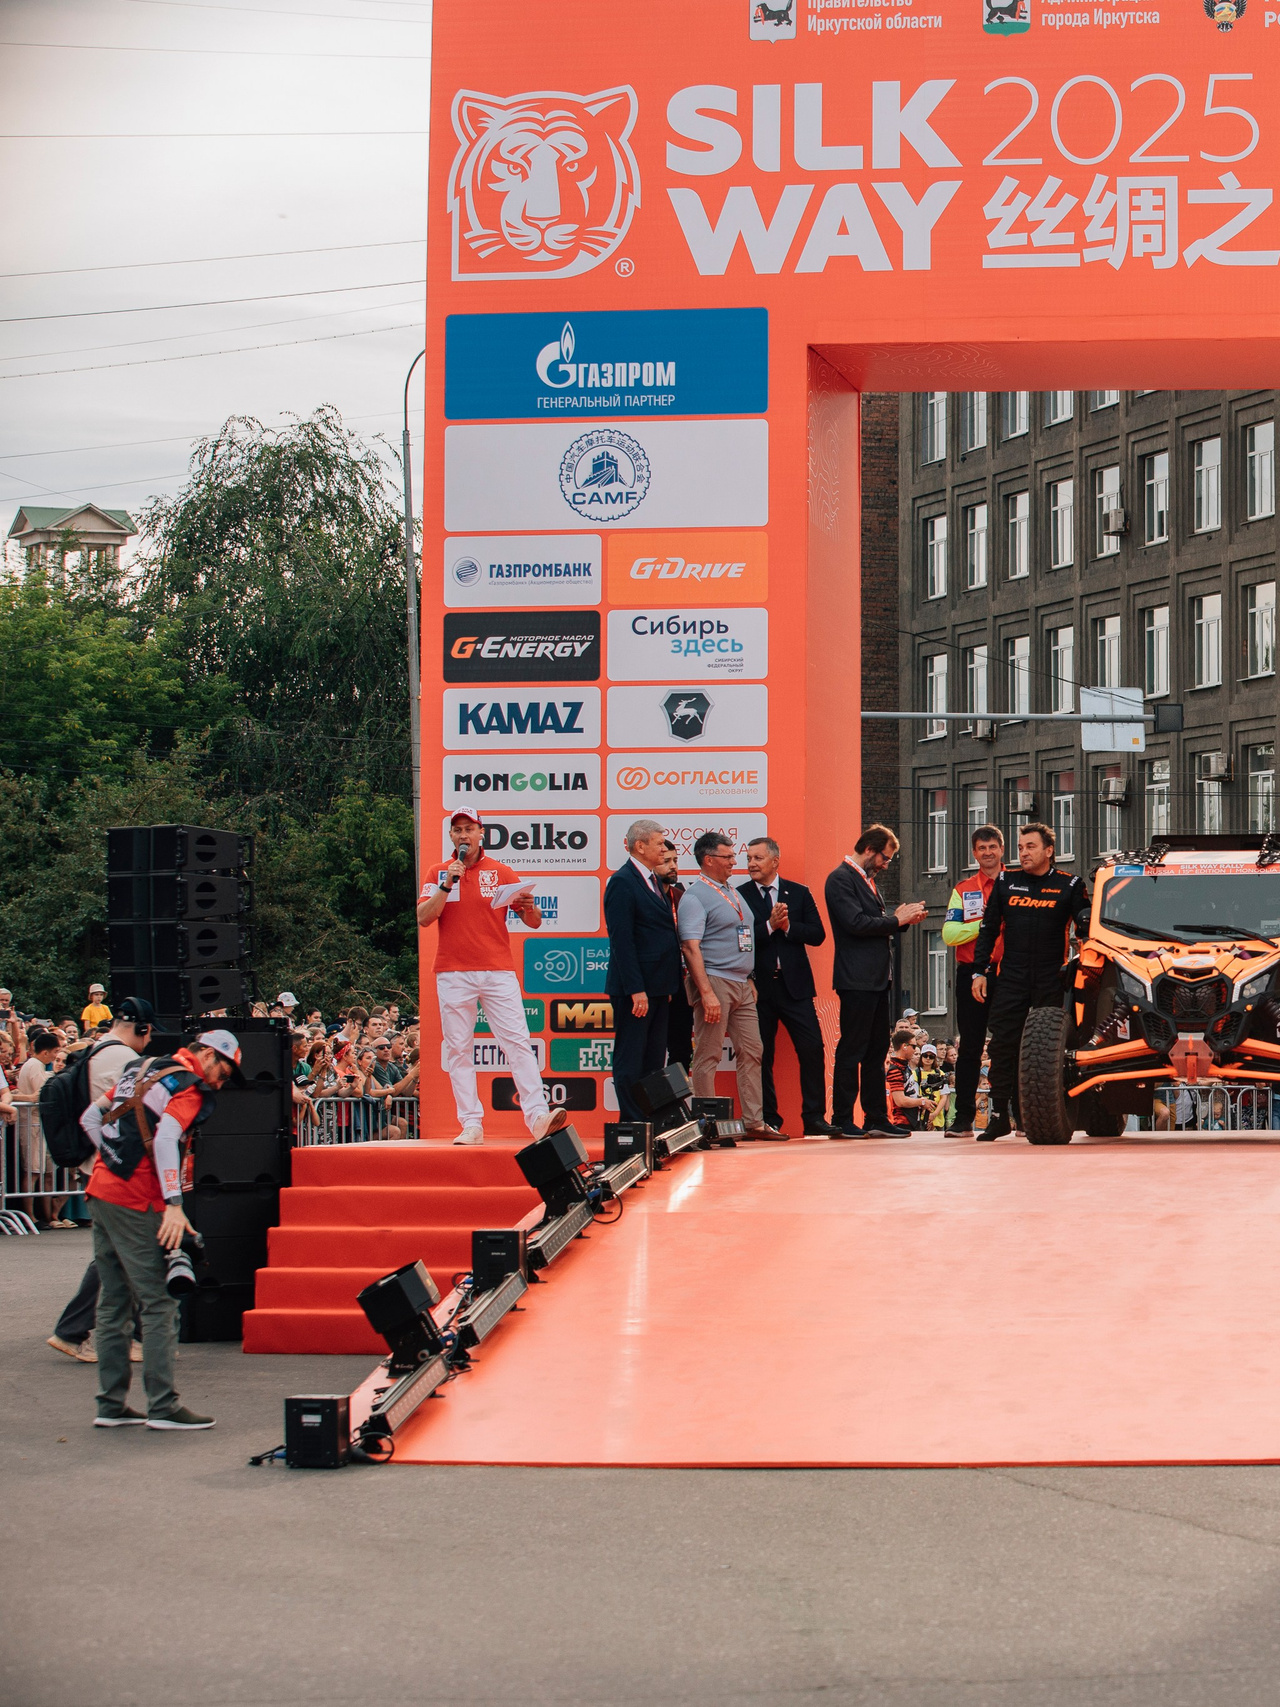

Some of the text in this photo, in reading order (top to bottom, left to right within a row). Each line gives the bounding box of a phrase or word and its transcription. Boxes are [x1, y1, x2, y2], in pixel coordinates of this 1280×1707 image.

[808, 12, 942, 35] Иркутской области
[1042, 8, 1160, 30] города Иркутска
[666, 79, 963, 176] SILK
[982, 73, 1259, 165] 2025
[666, 180, 963, 275] WAY
[578, 361, 676, 388] ГАЗПРОМ
[537, 394, 675, 409] ГЕНЕРАЛЬНЫЙ ПАРТНЕР
[572, 491, 637, 505] CAMF
[489, 563, 592, 578] ГАЗПРОМБАНК
[631, 615, 729, 639] Сибирь
[670, 638, 743, 657] здесь
[459, 702, 584, 735] KAMAZ
[454, 772, 588, 792] MONGOLIA
[653, 770, 758, 785] СОГЛАСИЕ
[699, 787, 758, 796] страхование
[482, 823, 588, 850] Delko
